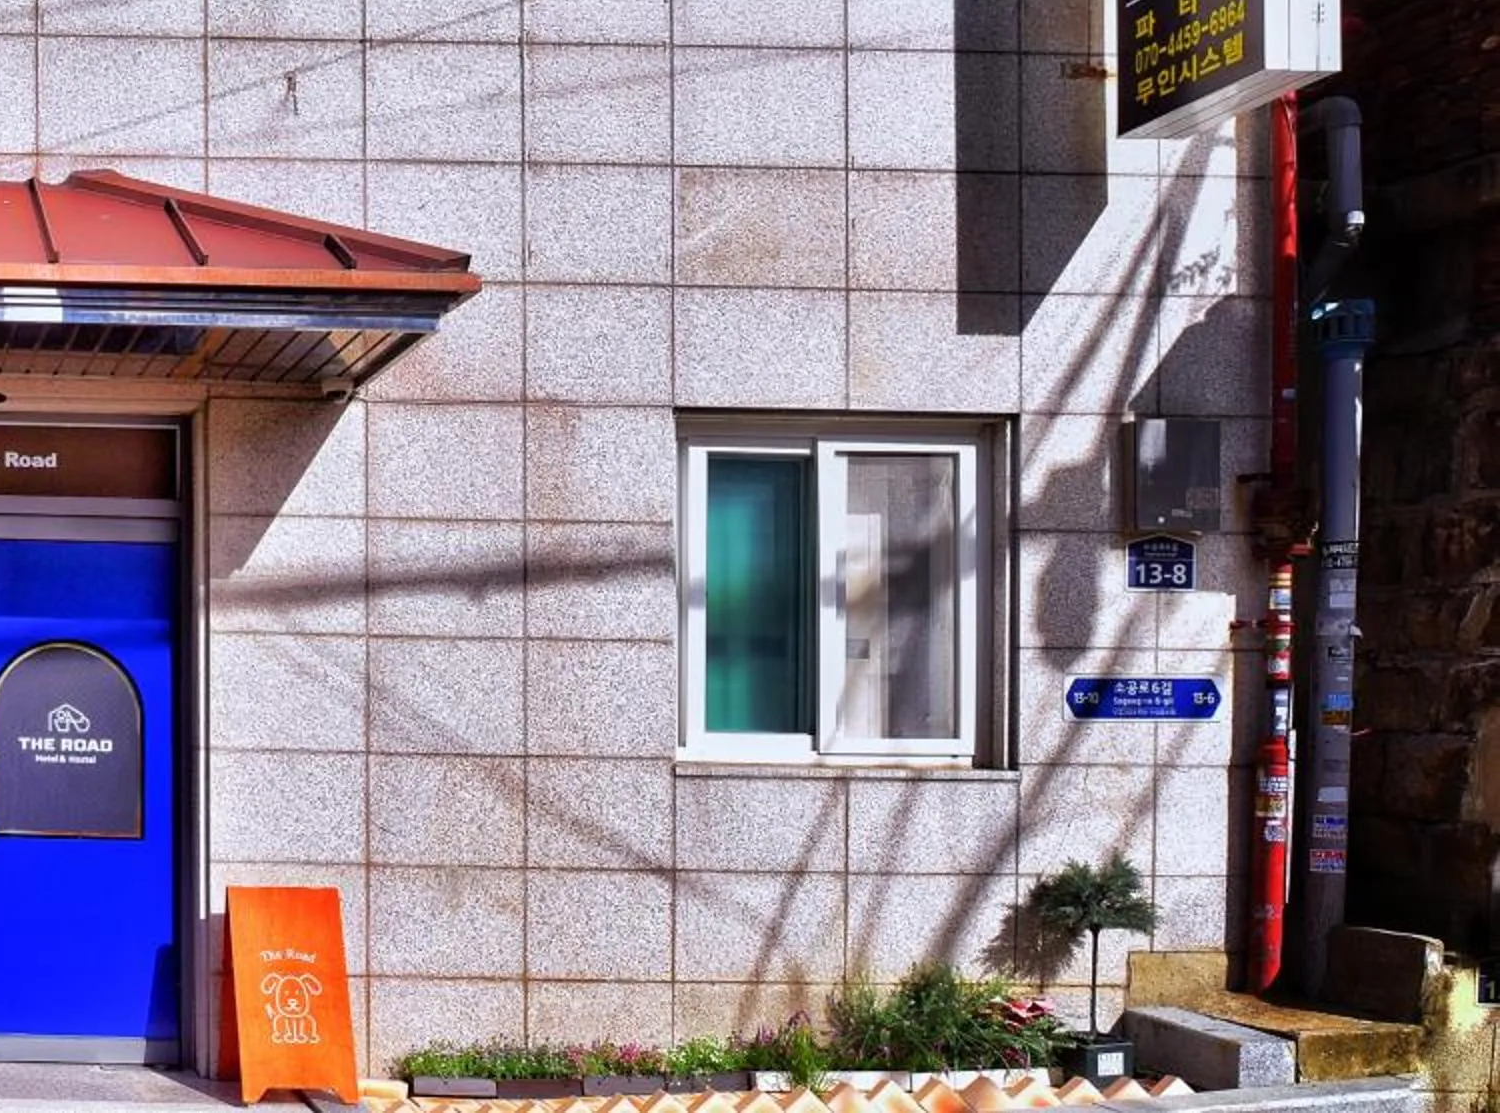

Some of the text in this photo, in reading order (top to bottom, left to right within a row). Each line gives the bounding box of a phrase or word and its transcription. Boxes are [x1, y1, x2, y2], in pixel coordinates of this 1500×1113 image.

[1134, 31, 1245, 105] 무인시스템
[5, 452, 58, 469] Road
[1135, 562, 1187, 585] 13-8
[17, 736, 113, 753] THE ROAD
